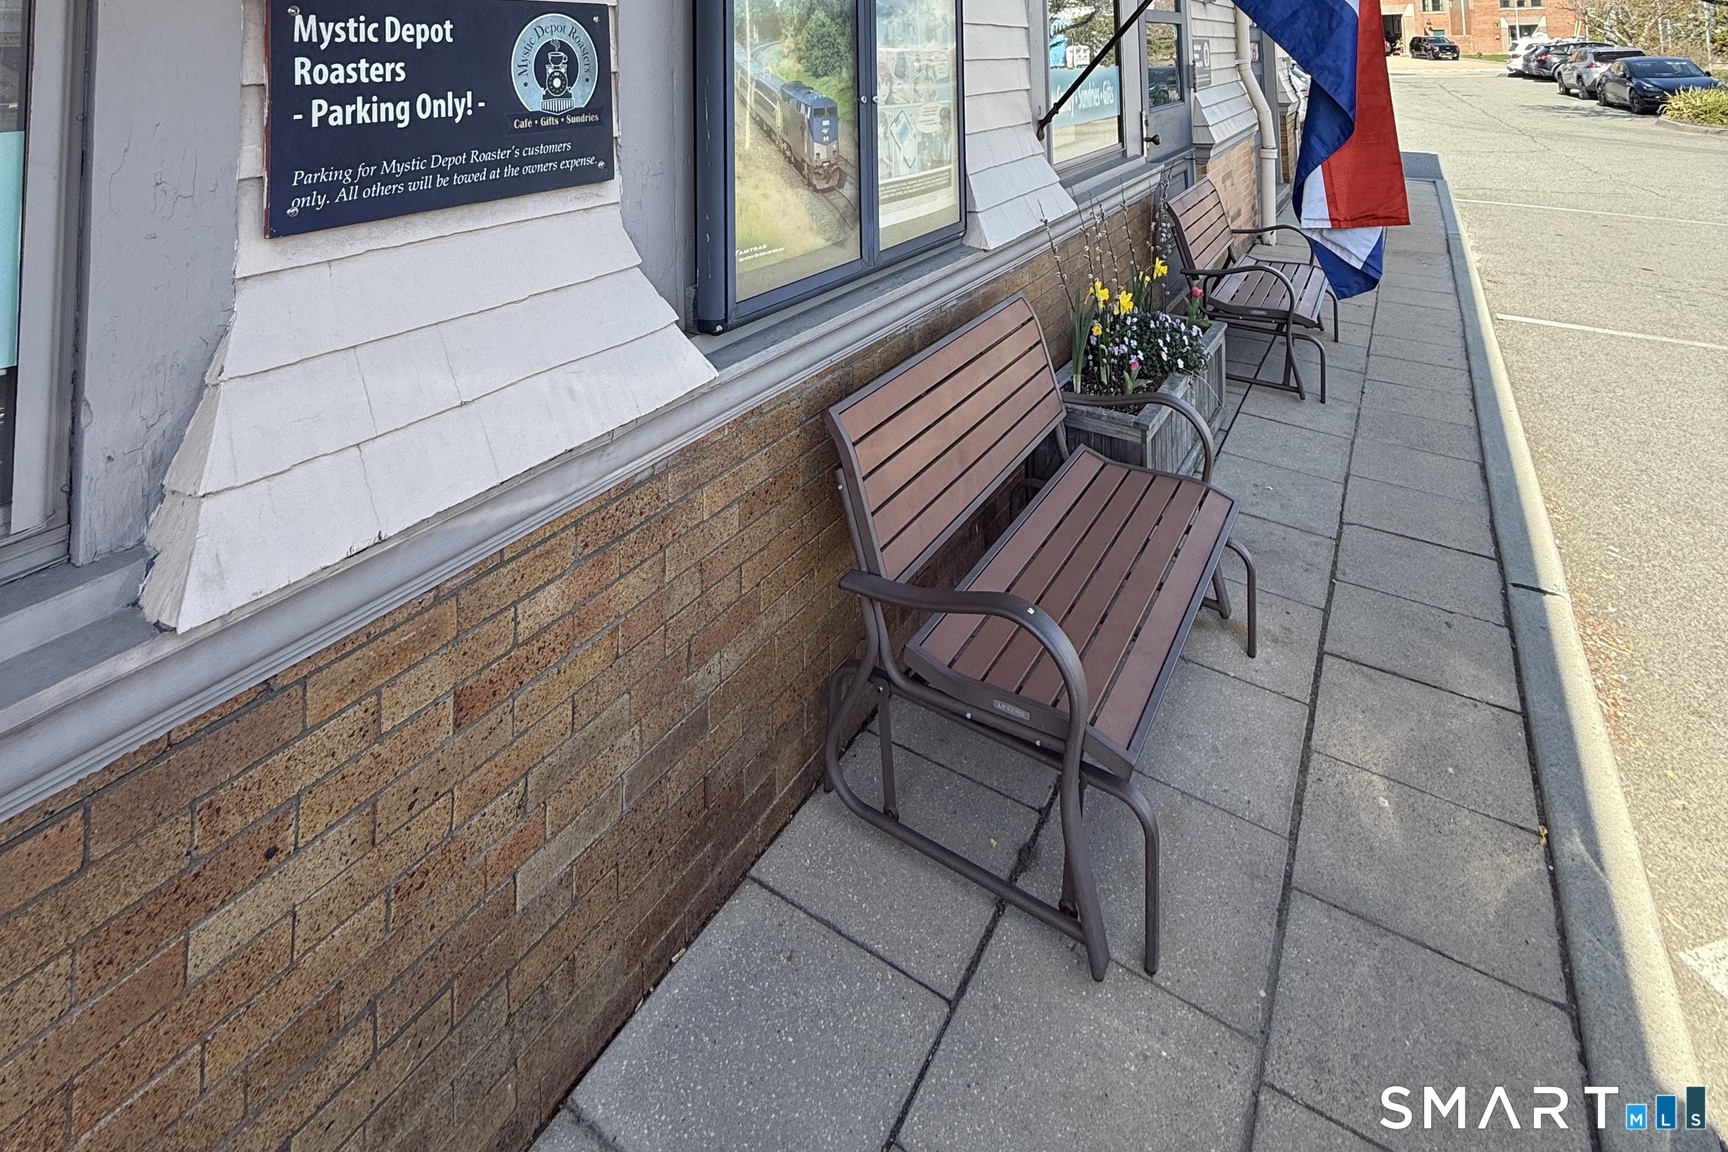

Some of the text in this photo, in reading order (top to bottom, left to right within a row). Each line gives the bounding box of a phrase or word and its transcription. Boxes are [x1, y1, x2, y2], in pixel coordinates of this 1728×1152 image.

[293, 14, 453, 51] Mystic Depot
[517, 24, 591, 77] Mystic Depot Roasters
[294, 56, 406, 85] Roasters
[311, 95, 410, 128] Parking
[416, 91, 473, 124] Only!
[513, 113, 599, 129] Café Gifts Sundries
[292, 142, 572, 186] Parking for Mystic Depot Roaster's customers
[291, 155, 598, 211] only. All others will be towed at the owners expense.
[738, 244, 767, 255] AMTRAK
